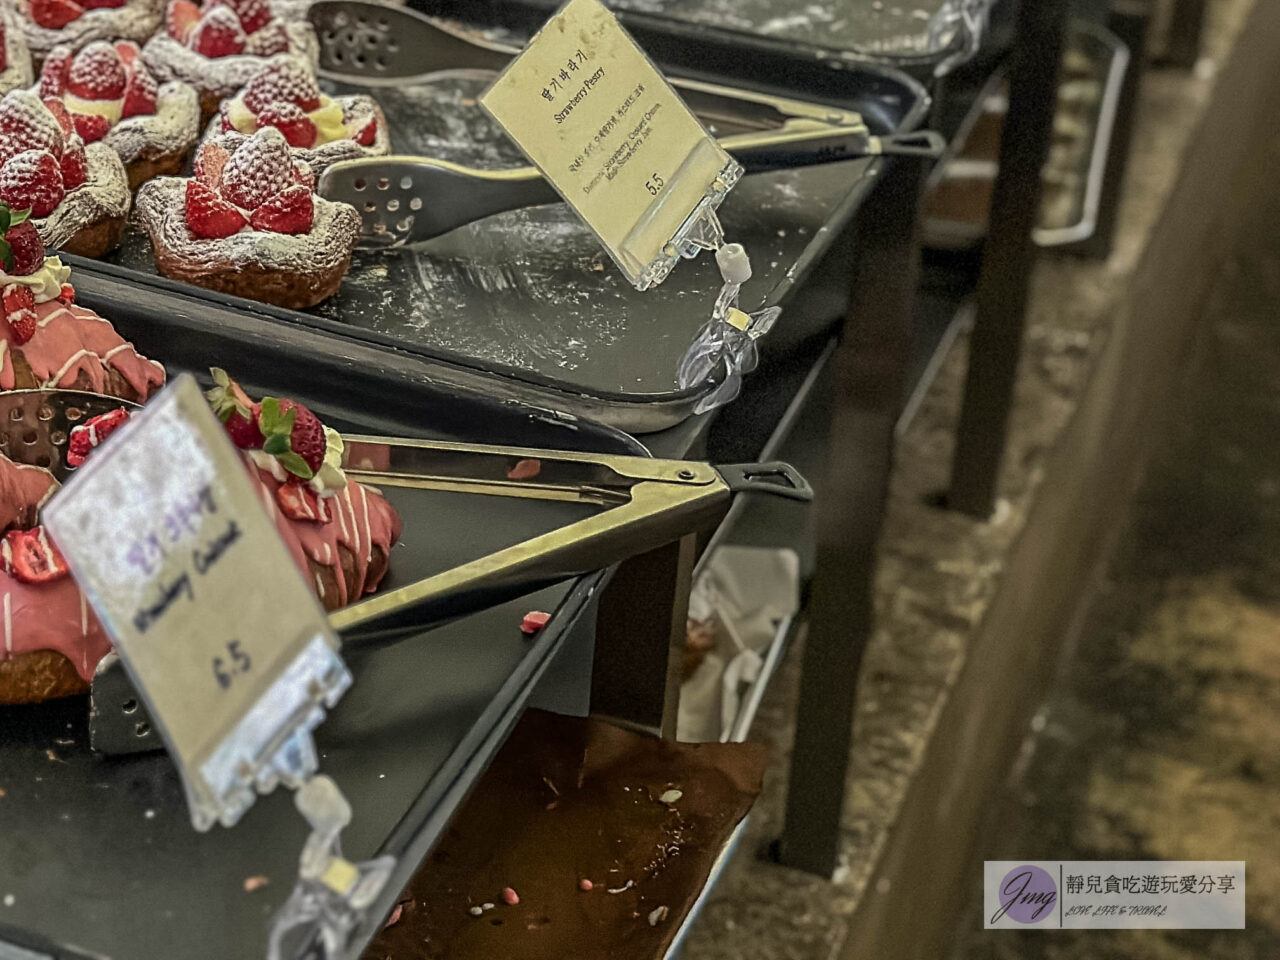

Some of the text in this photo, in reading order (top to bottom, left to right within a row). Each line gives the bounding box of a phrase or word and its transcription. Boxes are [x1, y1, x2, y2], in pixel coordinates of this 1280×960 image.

[554, 86, 588, 124] Strawberry
[645, 172, 665, 196] 5.5
[213, 639, 251, 690] 6.5
